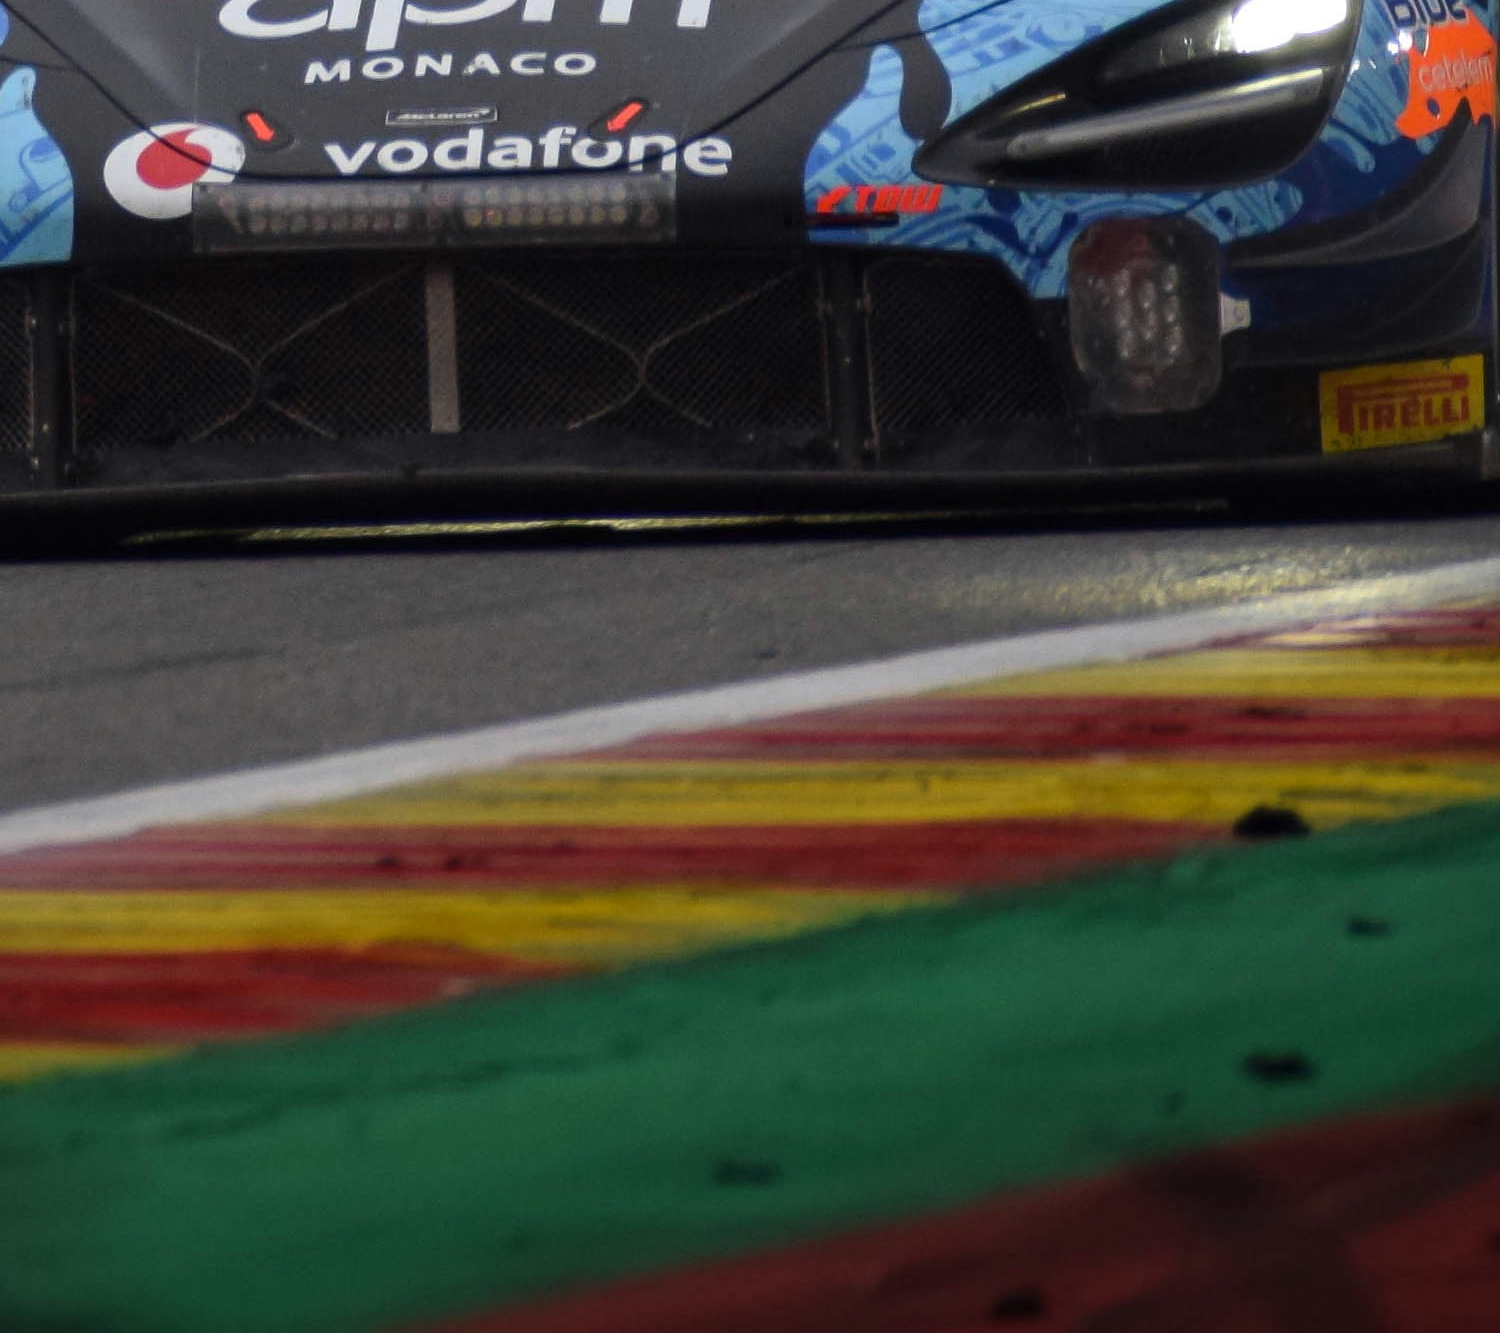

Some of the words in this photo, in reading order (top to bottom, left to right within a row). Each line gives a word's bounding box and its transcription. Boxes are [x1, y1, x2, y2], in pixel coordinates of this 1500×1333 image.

[303, 51, 597, 85] MONACO
[323, 126, 734, 177] vodafone
[1338, 374, 1470, 434] PIRELLI
